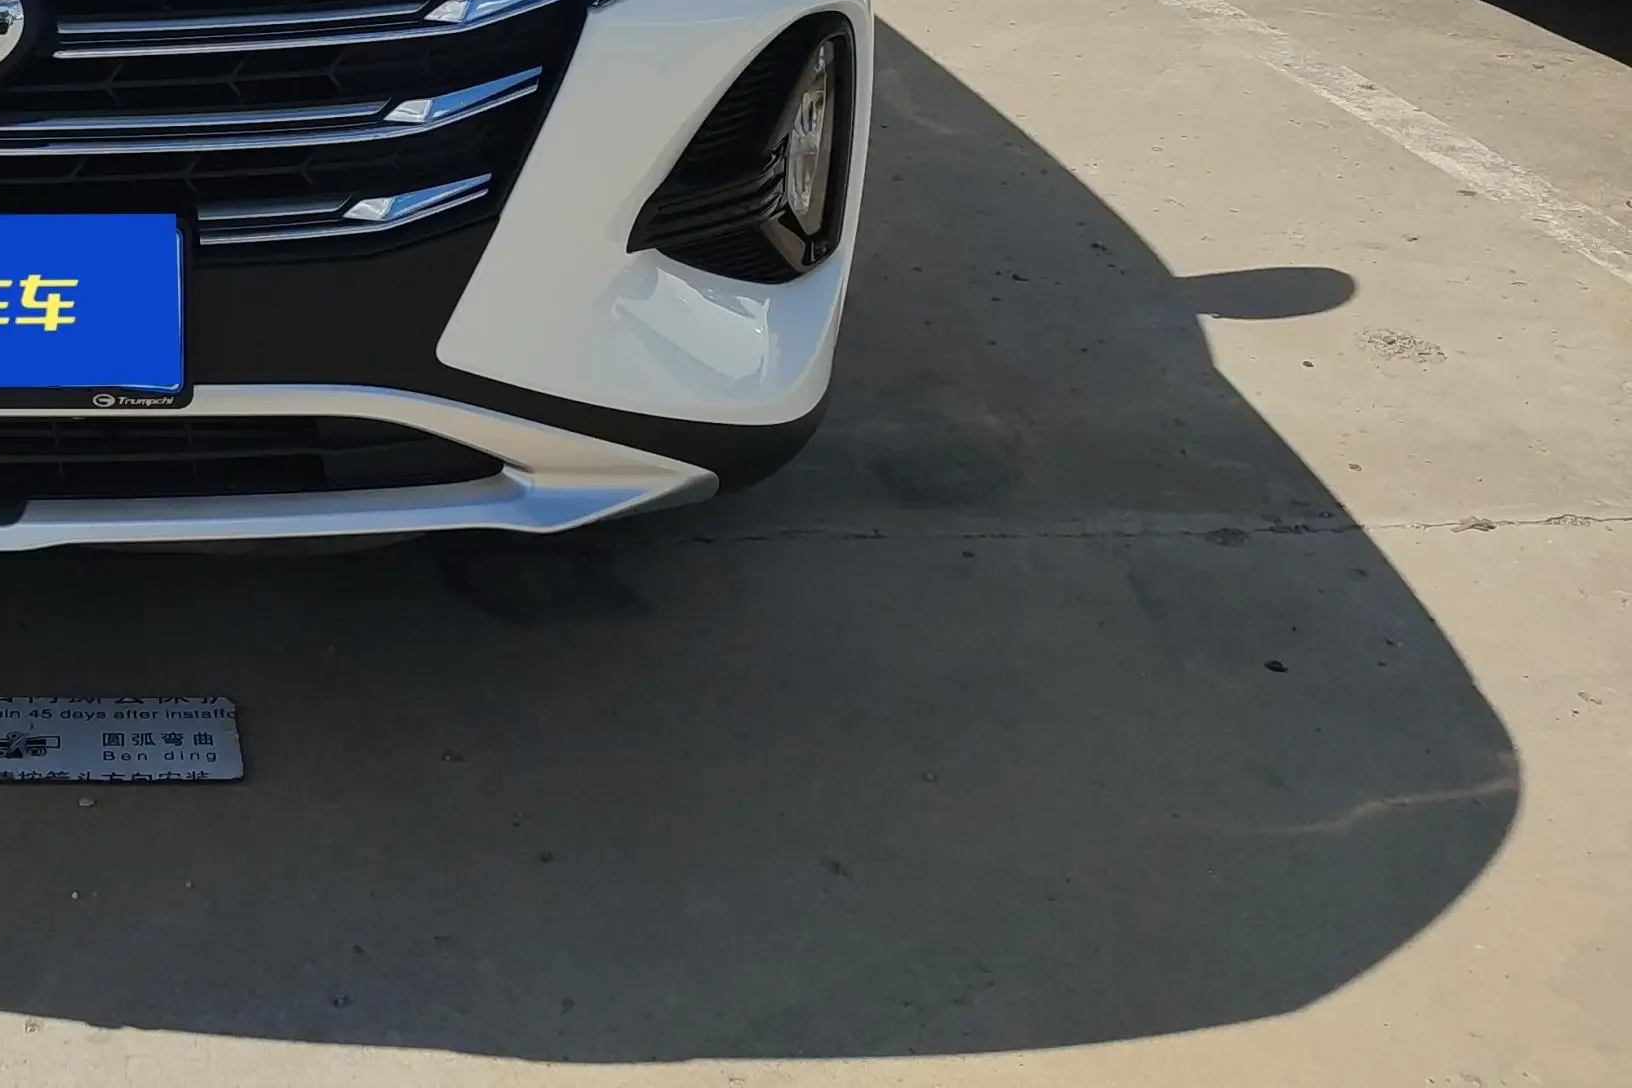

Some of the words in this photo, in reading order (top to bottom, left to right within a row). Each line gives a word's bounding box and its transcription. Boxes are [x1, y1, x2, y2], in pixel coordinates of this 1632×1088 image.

[117, 396, 175, 407] Trumpchi
[29, 708, 52, 719] 45
[60, 708, 107, 721] days
[113, 708, 157, 720] after
[102, 732, 214, 747] 圆弧弯曲
